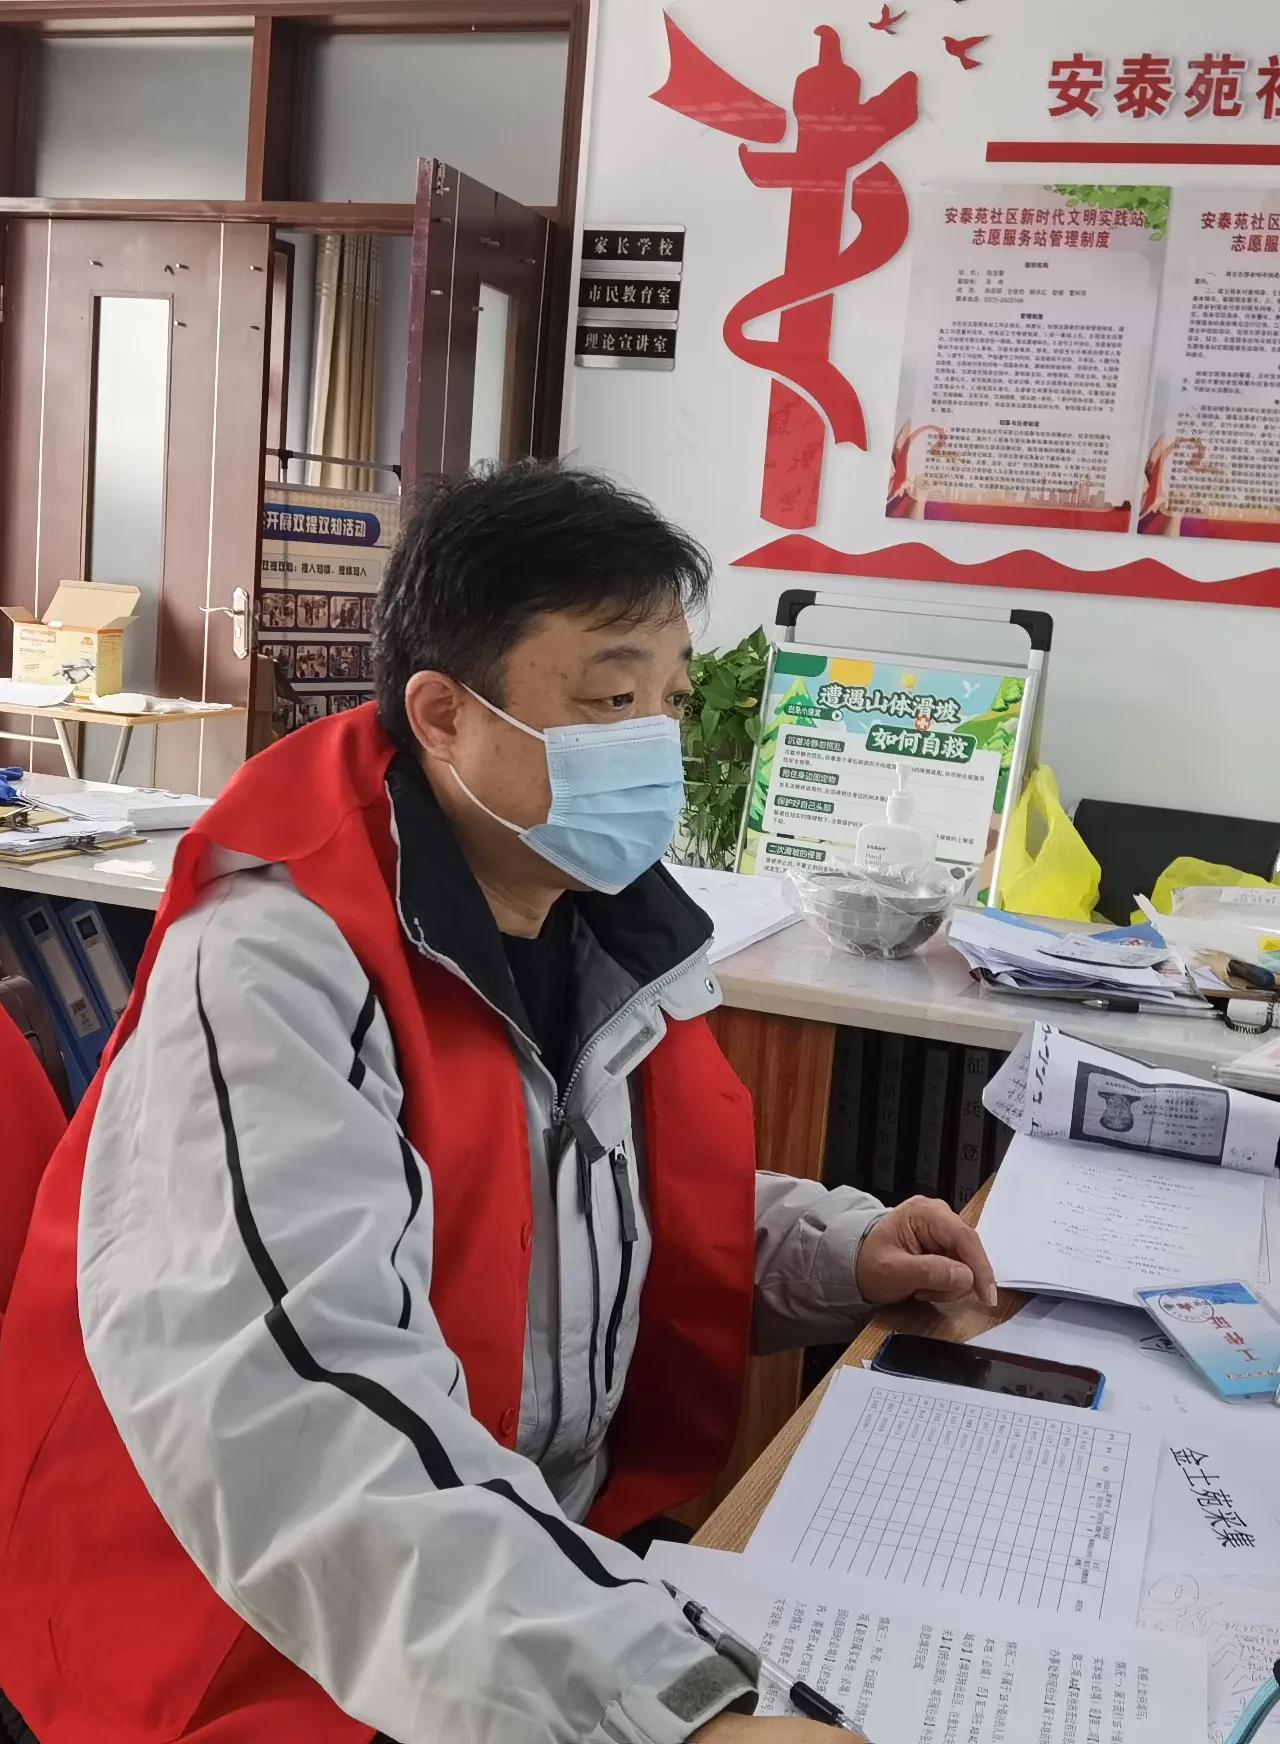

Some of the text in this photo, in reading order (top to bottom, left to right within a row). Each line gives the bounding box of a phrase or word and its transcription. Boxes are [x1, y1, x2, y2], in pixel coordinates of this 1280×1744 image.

[944, 206, 1145, 228] 安泰苑社区新时代文明实践站
[594, 236, 673, 256] 家长学校
[971, 227, 1111, 250] 志愿服务站管理制度
[588, 284, 672, 305] 市民教育室
[584, 332, 668, 353] 理论宣讲室
[262, 510, 367, 539] 开展双提双知活动
[817, 683, 962, 724] 遭遇山体滑坡
[871, 727, 969, 761] 如何自救
